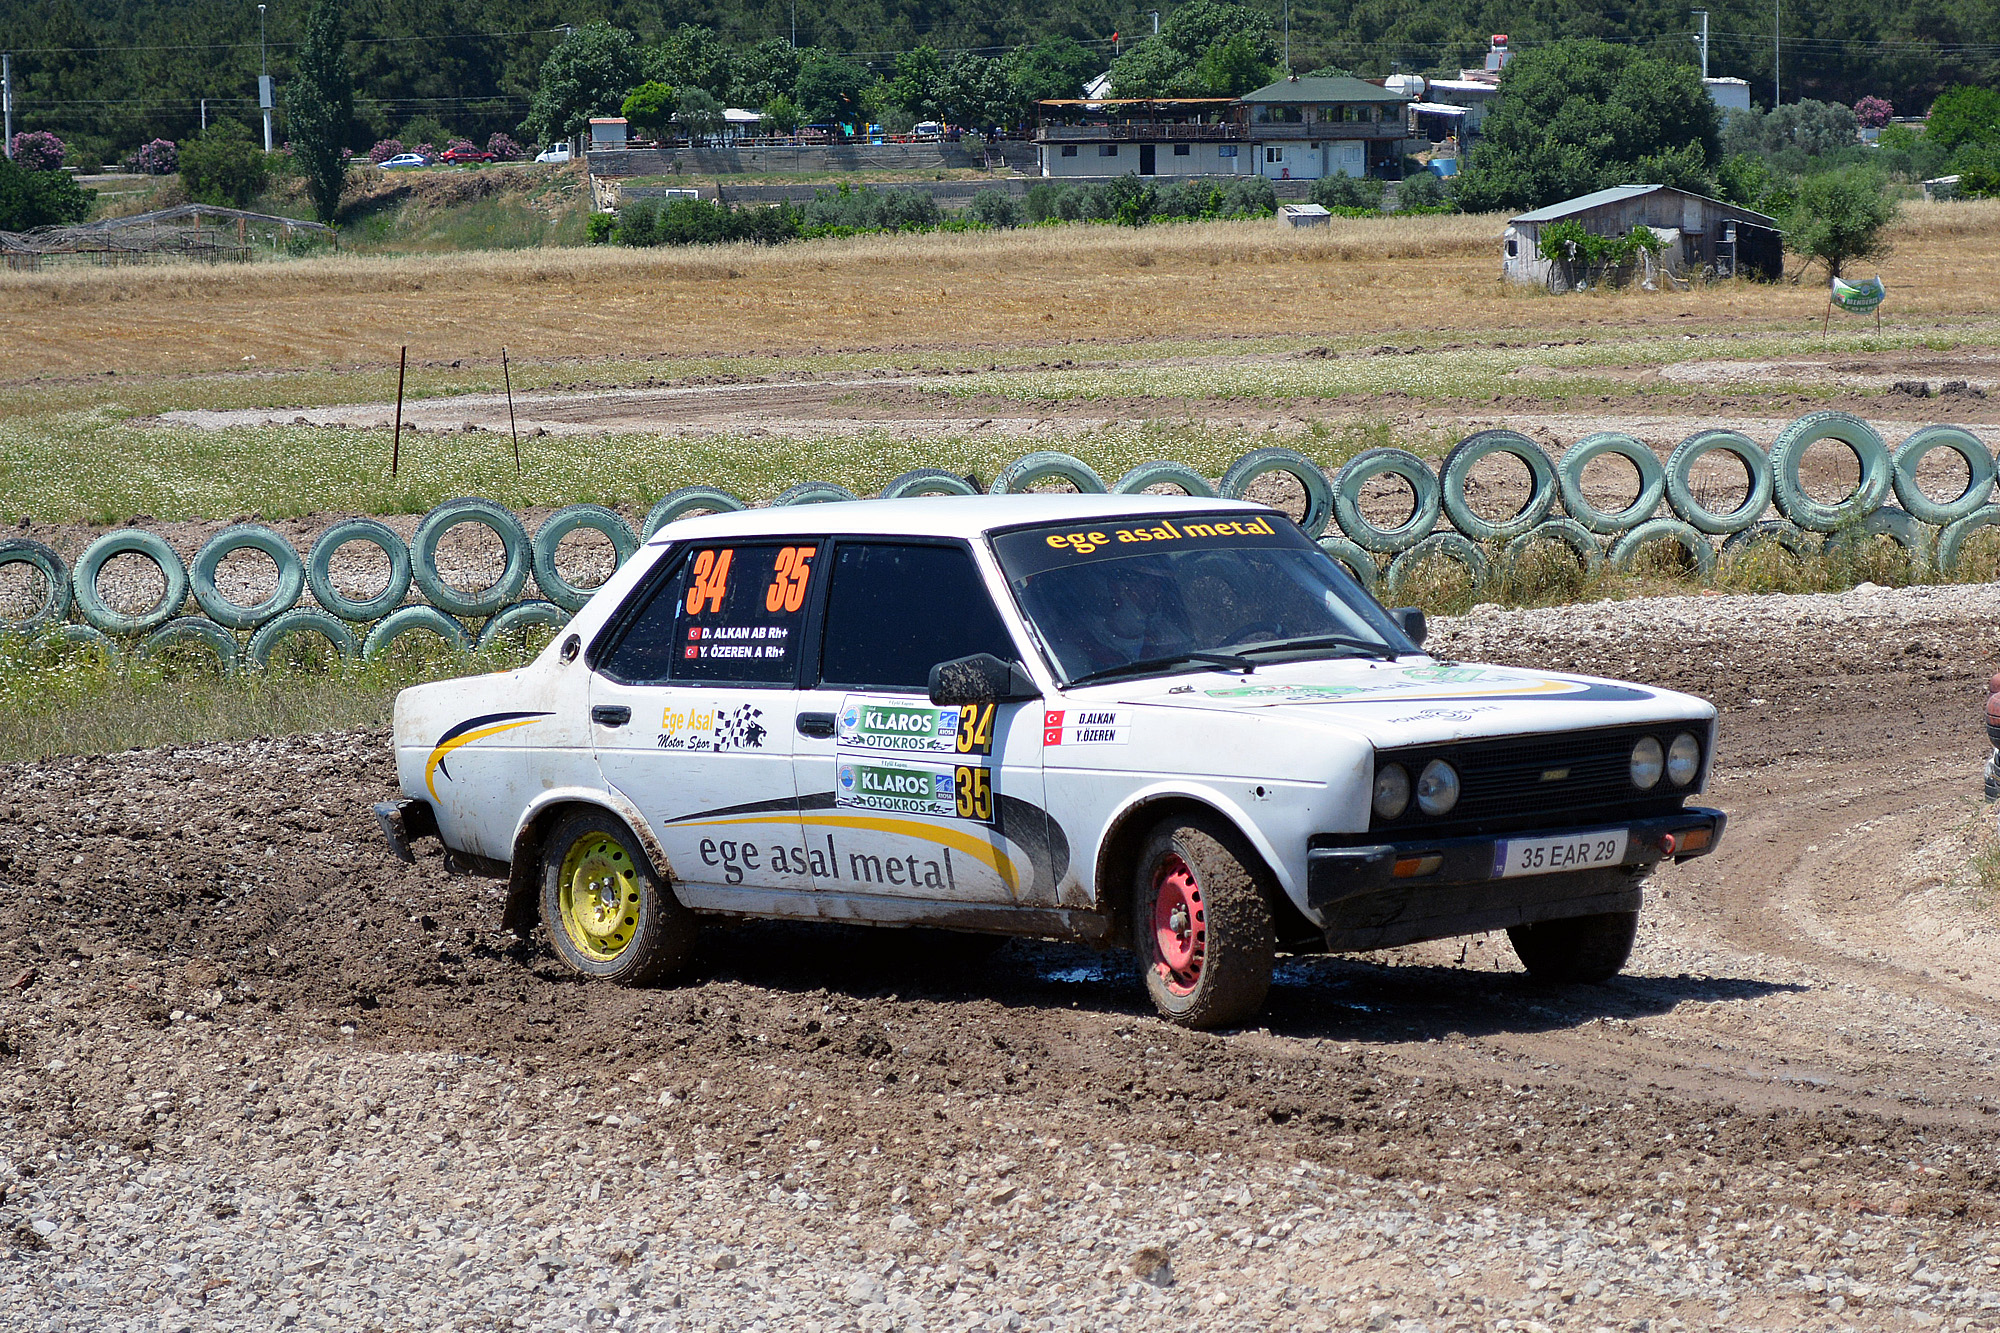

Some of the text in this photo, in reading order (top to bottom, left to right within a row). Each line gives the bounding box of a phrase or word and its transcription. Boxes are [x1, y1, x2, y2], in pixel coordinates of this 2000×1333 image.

[1046, 517, 1275, 554] ege asal metal
[686, 549, 733, 615] 34
[766, 547, 816, 612] 35
[702, 627, 788, 639] D. ALKAN AB Rh+
[700, 644, 785, 658] Y. ÖZEREN A Rh+
[662, 707, 715, 735] Ege Asal
[864, 711, 933, 733] KLAROS
[957, 703, 994, 753] 34
[1078, 713, 1116, 725] D.ALKAN
[657, 734, 711, 752] Motor Spor
[866, 735, 926, 750] OTOKROS
[1076, 728, 1116, 742] Y.ÖZEREN
[861, 772, 929, 795] KLAROS
[956, 766, 991, 819] 35
[867, 796, 926, 812] OTOKROS
[699, 833, 956, 890] ege asal metal
[1521, 840, 1616, 869] 35 EAR 29
